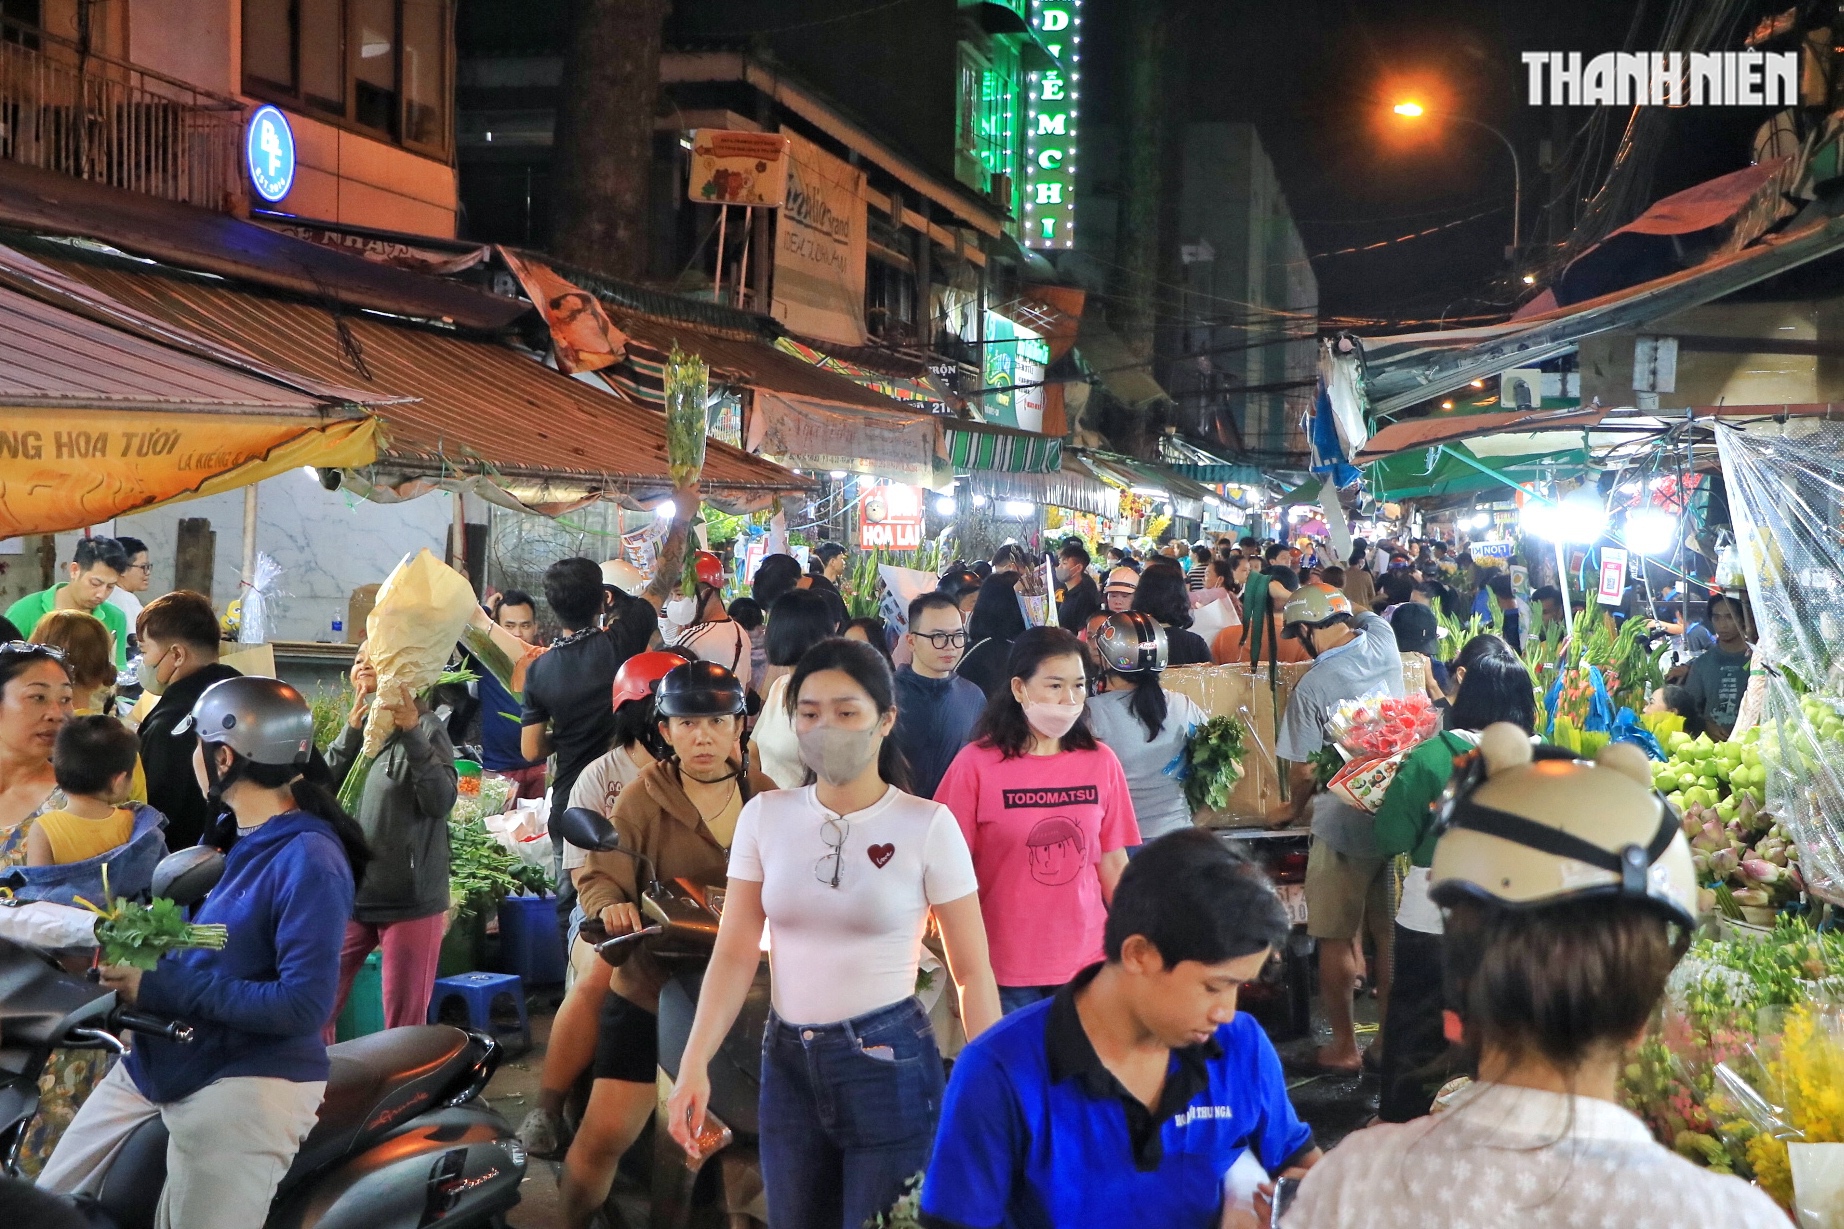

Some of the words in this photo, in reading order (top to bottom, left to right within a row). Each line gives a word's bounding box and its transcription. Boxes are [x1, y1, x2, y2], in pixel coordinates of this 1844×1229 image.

[928, 363, 957, 377] RỘN
[54, 430, 109, 460] HOA
[121, 427, 183, 459] TƯƠI
[177, 449, 197, 471] LÁ
[862, 524, 894, 546] HOA
[1006, 789, 1096, 805] TODOMATSU
[1214, 1105, 1233, 1118] NGA
